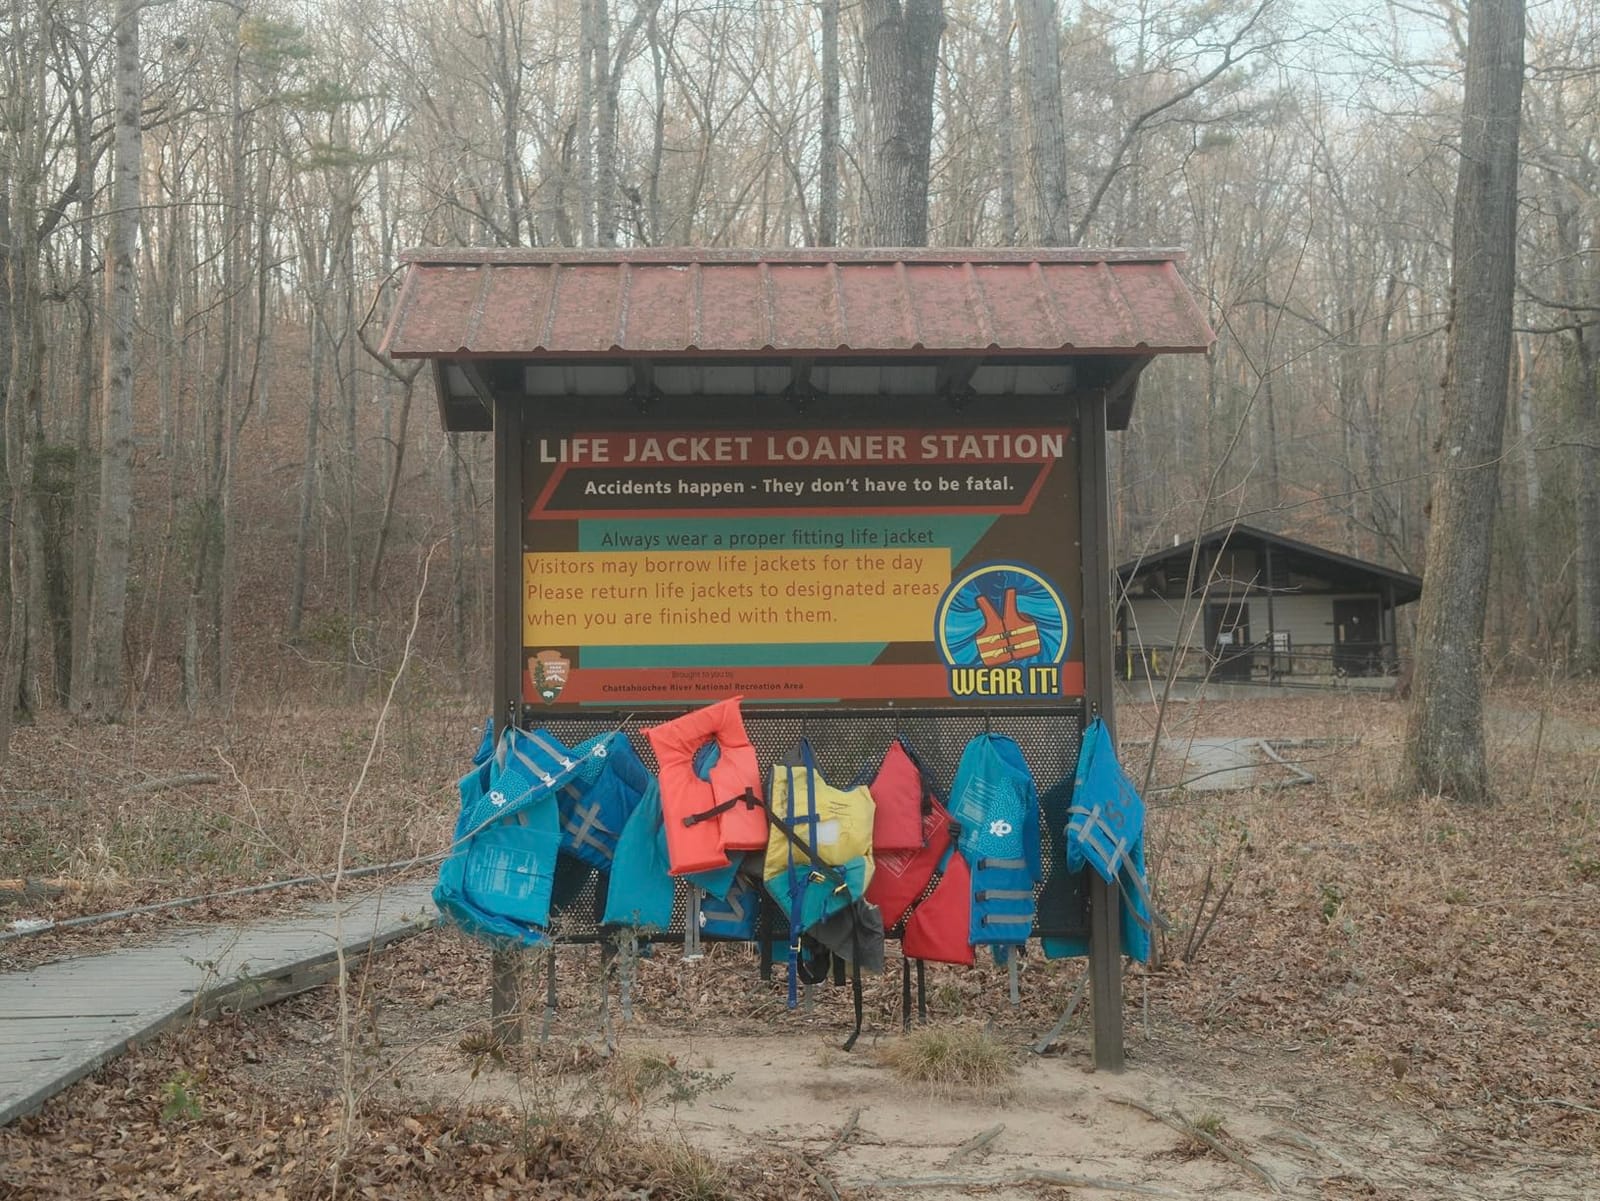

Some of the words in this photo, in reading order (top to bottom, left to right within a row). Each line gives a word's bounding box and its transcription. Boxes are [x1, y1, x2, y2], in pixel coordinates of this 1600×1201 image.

[540, 438, 609, 464] LIFE
[623, 437, 753, 463] JACKET
[767, 435, 907, 461] LOANER
[921, 434, 1064, 460] STATION
[584, 480, 672, 496] Accidents
[678, 481, 745, 500] happen
[762, 479, 805, 499] They
[811, 478, 858, 494] don't
[864, 477, 908, 493] have
[913, 478, 932, 492] to
[938, 477, 960, 492] be
[965, 476, 1014, 492] fatal.
[601, 532, 661, 550] Always
[666, 534, 707, 546] wear
[714, 534, 723, 545] a
[729, 533, 785, 550] proper
[792, 530, 844, 549] fitting
[851, 529, 878, 545] life
[883, 528, 934, 548] jacket
[526, 557, 595, 574] Visitors
[601, 561, 638, 578] may
[645, 557, 710, 574] borrow
[718, 556, 747, 572] life
[753, 556, 816, 575] jackets
[823, 555, 849, 571] for
[856, 555, 886, 571] the
[891, 554, 923, 574] day
[526, 583, 584, 600] Please
[591, 585, 648, 600] return
[655, 582, 684, 599] life
[691, 582, 753, 603] jackets
[760, 584, 779, 598] to
[785, 581, 885, 602] designated
[892, 583, 941, 597] areas
[526, 609, 577, 626] when
[583, 613, 617, 630] you
[623, 612, 652, 625] are
[659, 607, 731, 625] finished
[738, 607, 778, 623] with
[785, 606, 838, 623] them.
[602, 684, 666, 693] Chattahoochee
[670, 683, 692, 692] River
[695, 682, 732, 691] National
[734, 682, 782, 691] Recreation
[783, 681, 804, 690] Area
[951, 667, 1024, 696] WEAR
[1029, 667, 1059, 695] IT!
